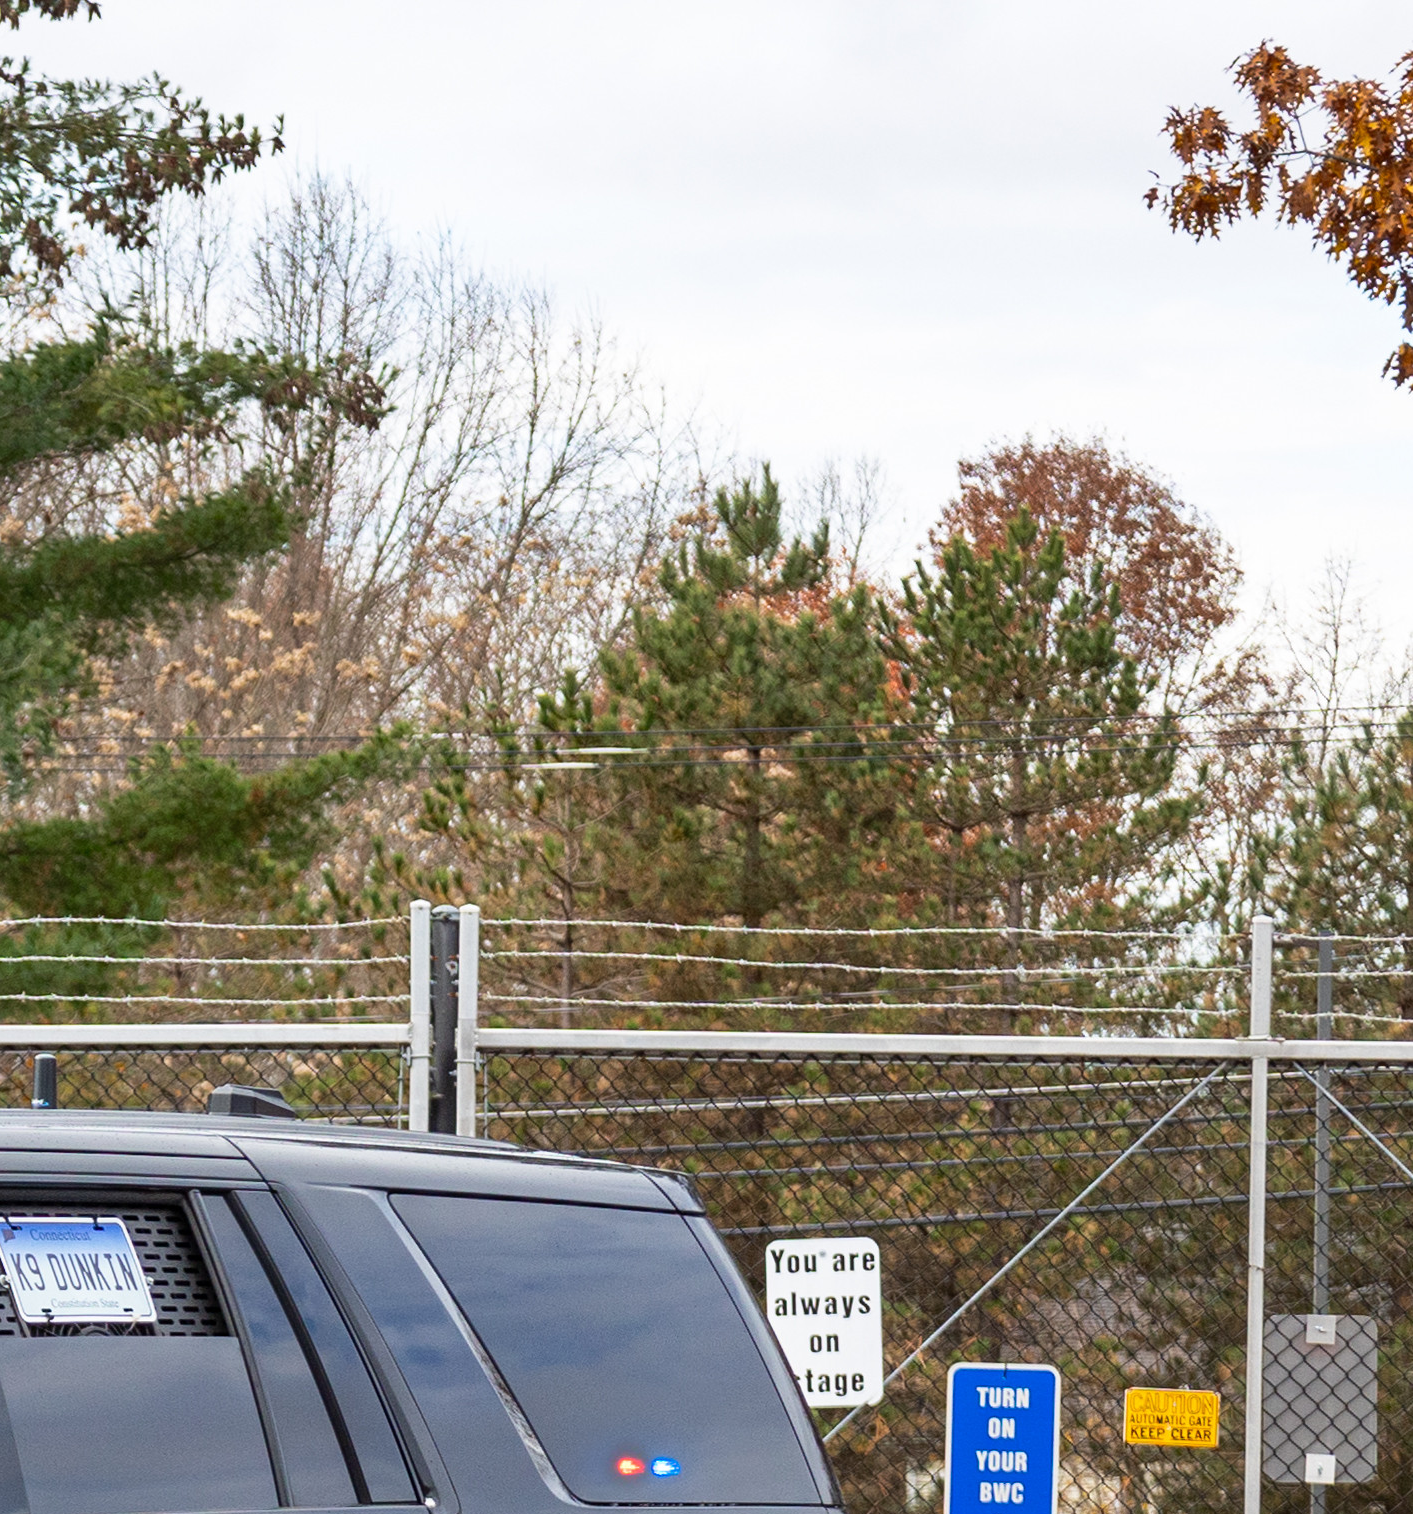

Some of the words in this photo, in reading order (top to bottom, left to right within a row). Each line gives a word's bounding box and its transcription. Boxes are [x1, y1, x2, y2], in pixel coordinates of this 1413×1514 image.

[29, 1228, 92, 1242] Connecticut
[9, 1253, 46, 1291] K9
[46, 1253, 139, 1291] DUNKIN
[770, 1249, 817, 1273] You
[832, 1252, 875, 1272] are
[50, 1298, 99, 1308] Constitution
[100, 1299, 119, 1308] State
[775, 1291, 871, 1318] always
[809, 1333, 840, 1353] on
[795, 1368, 865, 1397] tage
[976, 1386, 1030, 1409] TURN
[1129, 1392, 1214, 1415] CAUTION
[987, 1417, 1016, 1439] ON
[1129, 1414, 1186, 1426] AUTOMATIC
[1188, 1416, 1213, 1427] GATE
[1130, 1426, 1165, 1440] KEEP
[1171, 1427, 1212, 1441] CLEAR
[976, 1450, 1028, 1473] YOUR
[979, 1481, 1025, 1504] BWC
